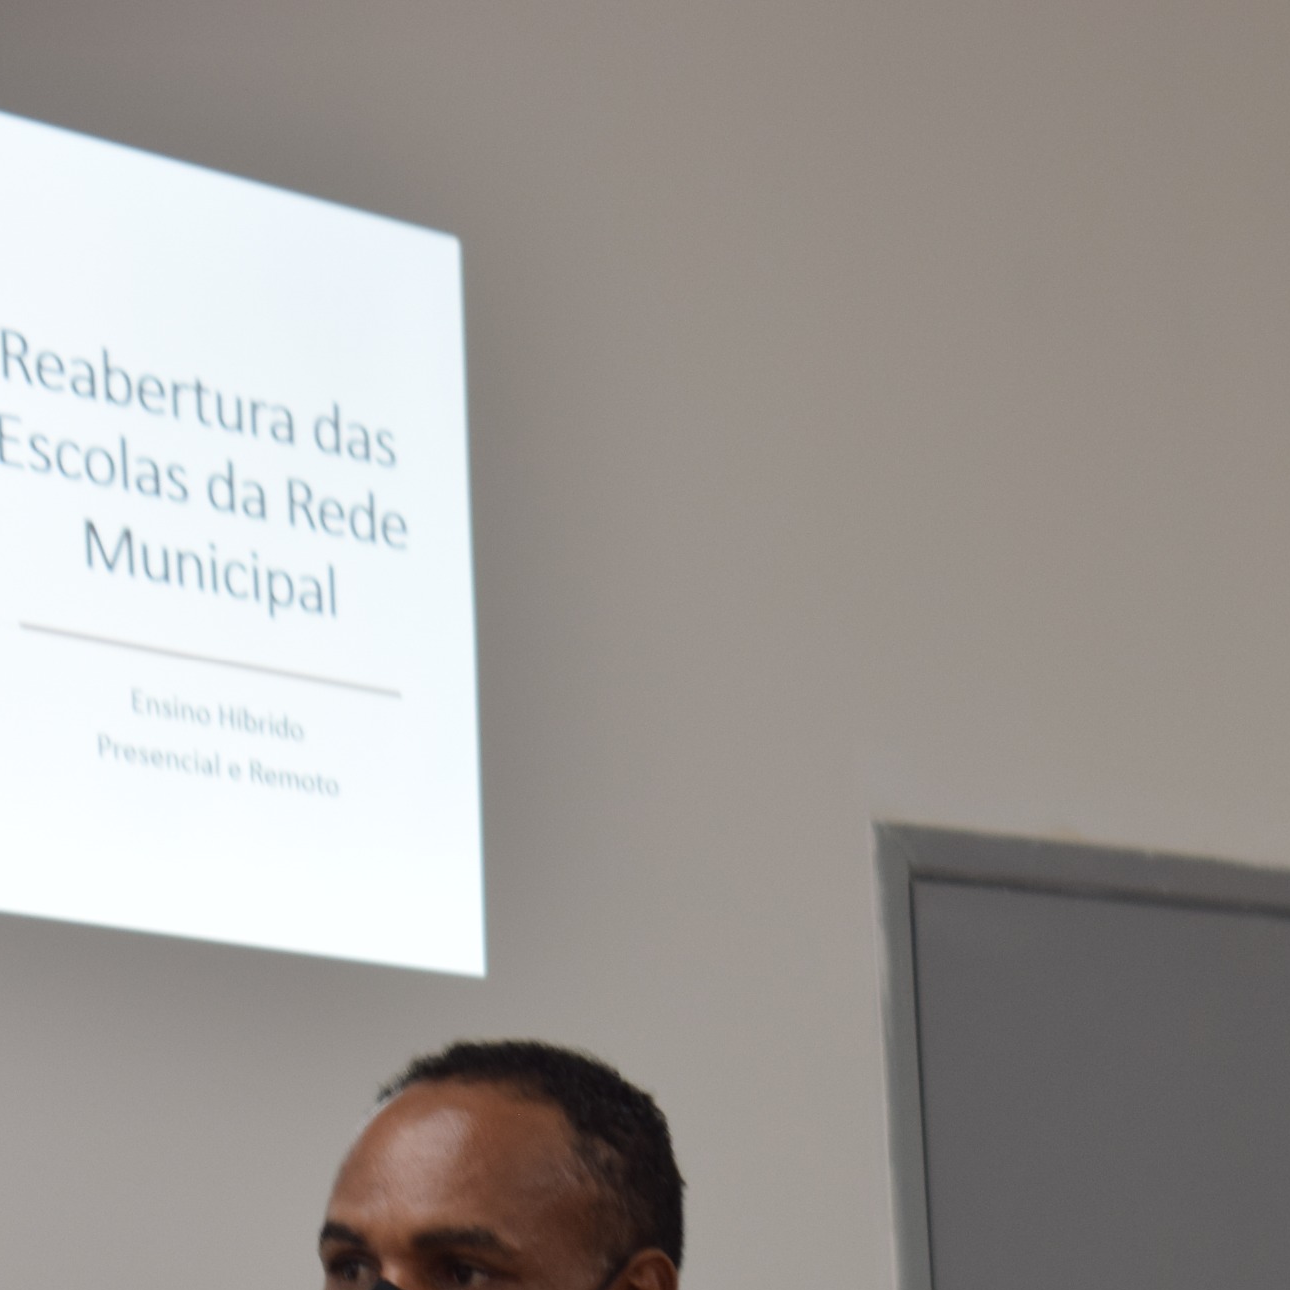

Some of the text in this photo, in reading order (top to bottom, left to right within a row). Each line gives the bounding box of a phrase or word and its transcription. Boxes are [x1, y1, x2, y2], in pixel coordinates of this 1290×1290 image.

[0, 326, 398, 469] Reabertura das
[208, 460, 267, 521] da
[287, 477, 409, 551] Rede
[83, 518, 338, 619] Municipal
[130, 686, 211, 726] Ensino
[97, 732, 341, 798] Presencial e Remoto
